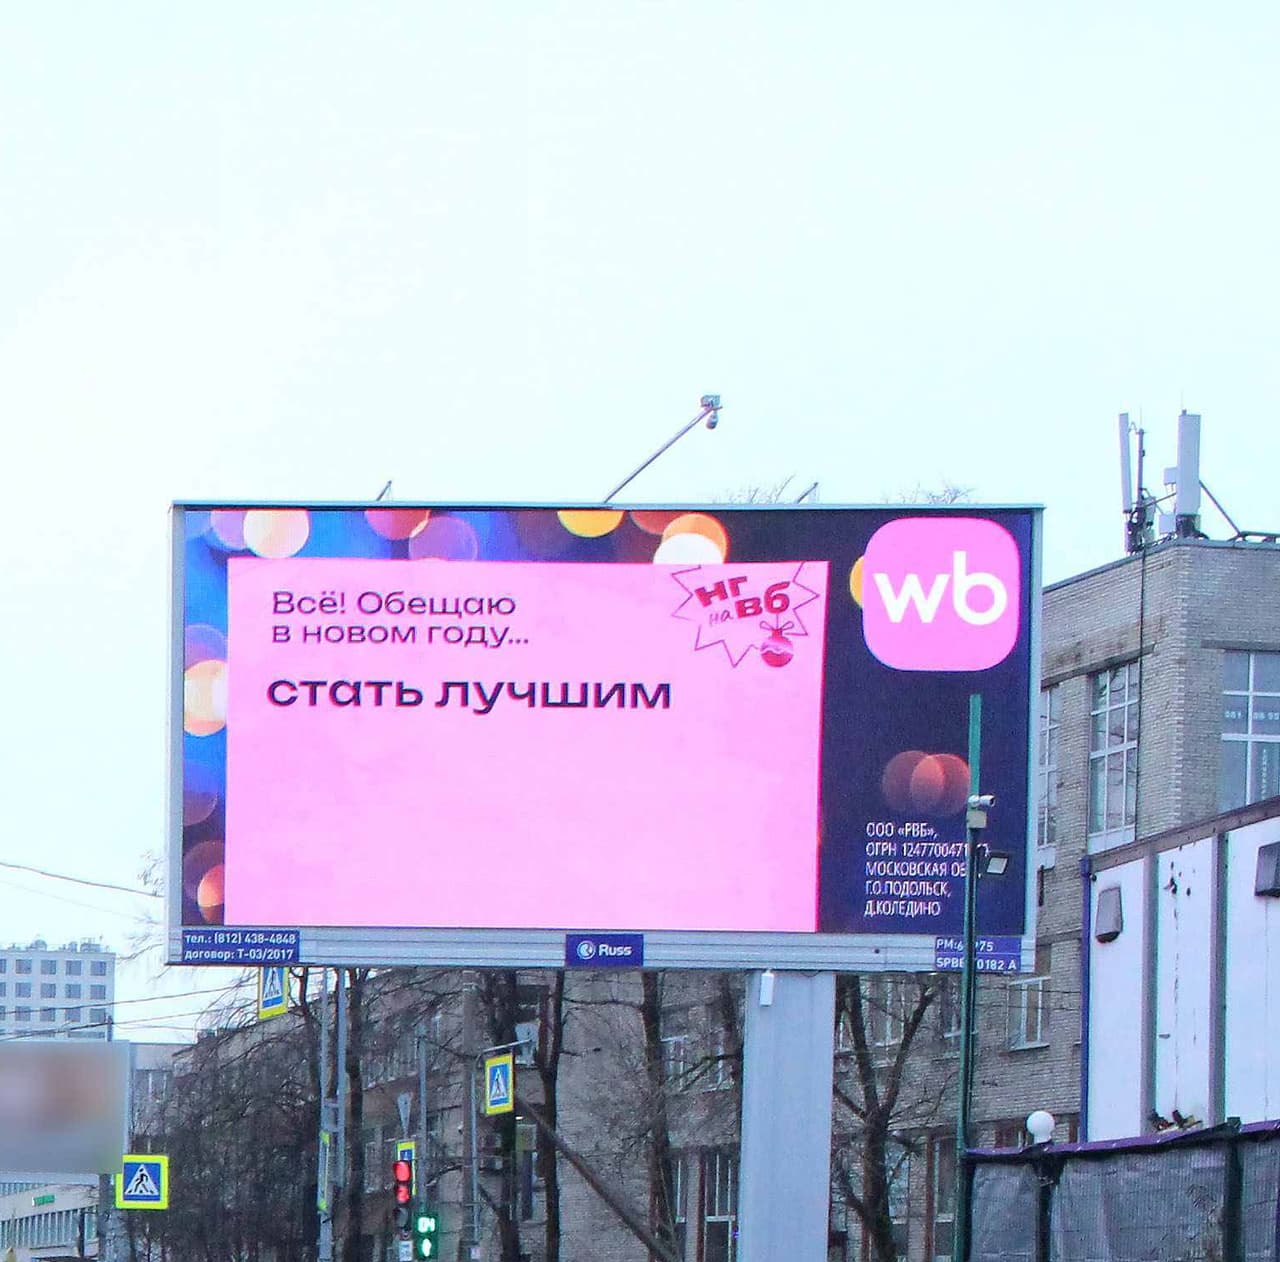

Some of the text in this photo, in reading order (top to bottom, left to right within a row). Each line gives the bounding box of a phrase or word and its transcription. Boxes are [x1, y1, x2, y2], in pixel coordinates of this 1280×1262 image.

[873, 550, 1008, 626] wb
[272, 590, 517, 618] Всё! Обещаю
[708, 610, 735, 628] на
[271, 624, 530, 649] в новом году...
[266, 679, 672, 716] стать лучшим
[866, 822, 938, 839] ООО «РВБ»,
[865, 842, 897, 857] ОГРН
[865, 861, 948, 877] МОСКОВСКАЯ
[184, 931, 297, 945] тел.: (812) 438-4848
[184, 948, 294, 961] договор: Т-03/2017
[598, 943, 633, 957] Russ
